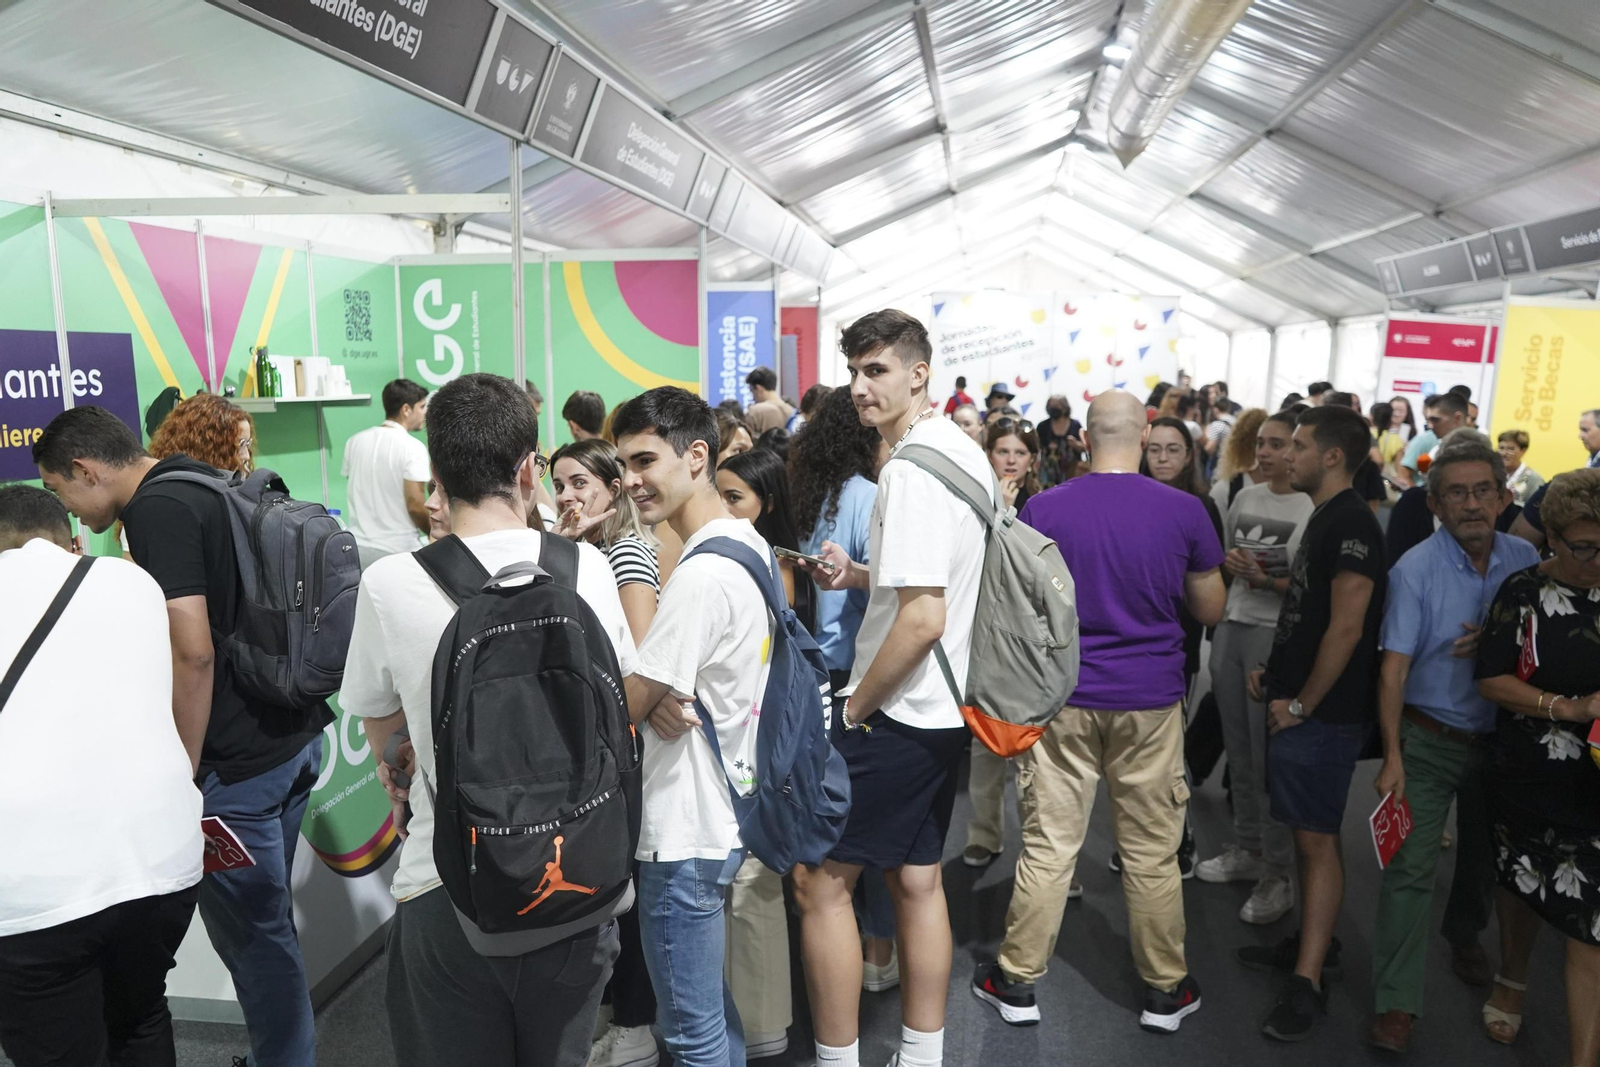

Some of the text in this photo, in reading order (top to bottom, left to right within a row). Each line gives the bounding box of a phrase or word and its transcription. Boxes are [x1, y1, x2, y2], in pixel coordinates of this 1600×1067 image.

[374, 10, 423, 59] (DGE)
[737, 316, 759, 373] (SAE)
[944, 357, 959, 367] de
[1514, 333, 1543, 423] Servicio
[1535, 334, 1565, 432] de Becas
[533, 616, 569, 628] JORDAN
[311, 771, 376, 820] Delegación General de
[574, 791, 610, 818] JORDAN
[524, 820, 561, 835] JORDAN
